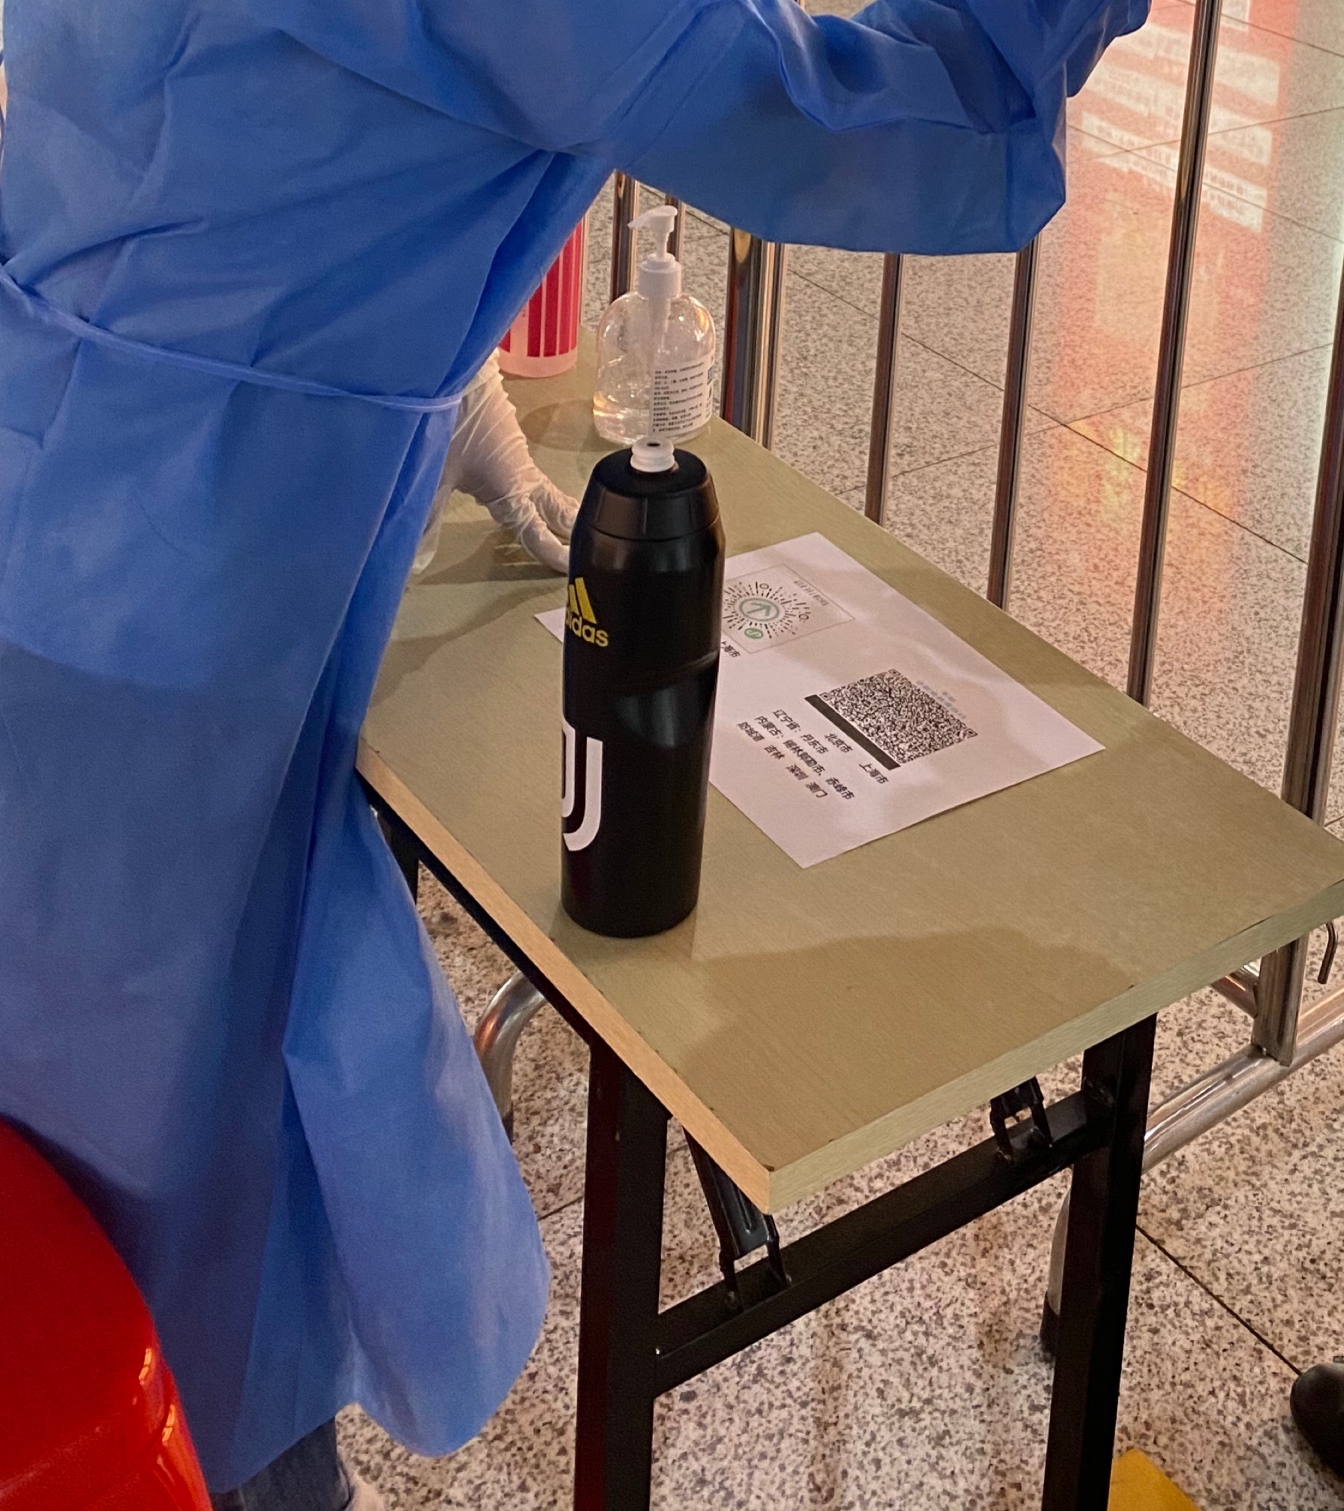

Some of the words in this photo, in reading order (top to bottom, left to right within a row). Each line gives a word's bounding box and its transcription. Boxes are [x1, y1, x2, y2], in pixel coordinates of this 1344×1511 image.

[566, 605, 609, 648] didas
[824, 733, 853, 753] 北京市
[859, 763, 889, 784] 上海市
